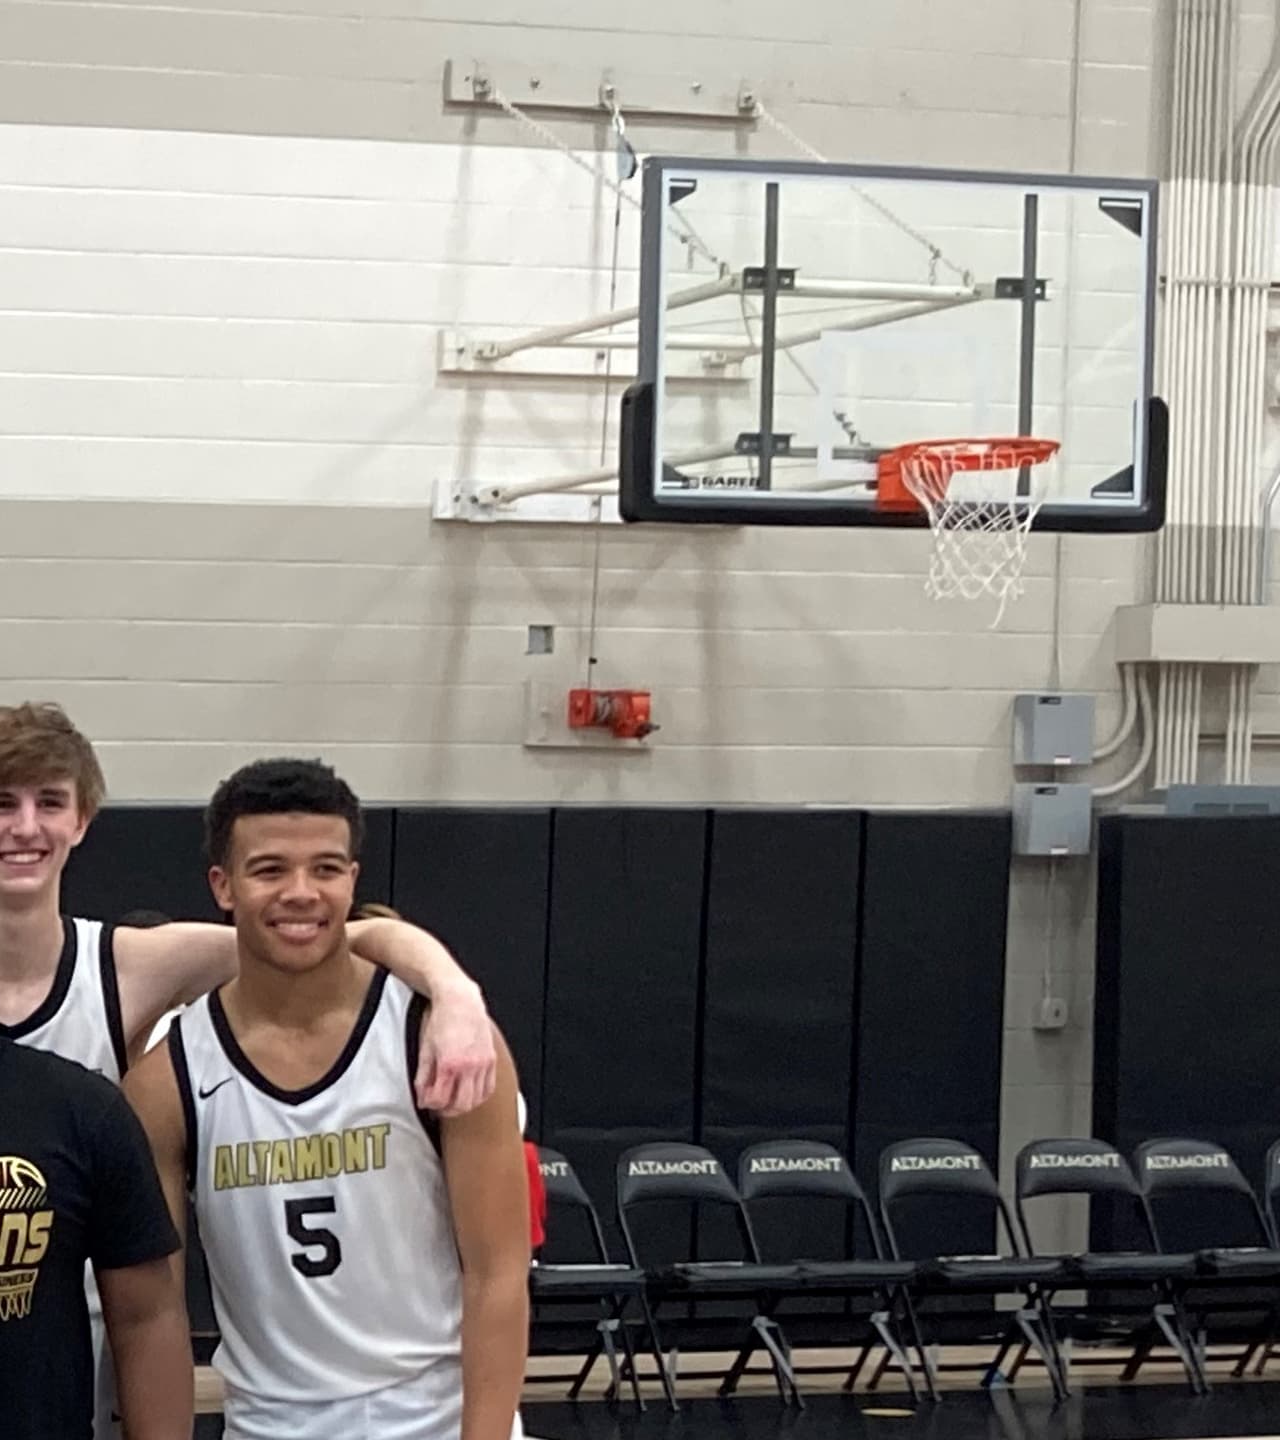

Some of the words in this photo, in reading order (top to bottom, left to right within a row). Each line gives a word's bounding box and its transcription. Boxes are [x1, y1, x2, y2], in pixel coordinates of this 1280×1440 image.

[214, 1123, 391, 1191] ALTAMONT
[750, 1157, 841, 1173] ALTAMONT
[891, 1155, 982, 1171] ALTAMONT
[1030, 1153, 1121, 1169] ALTAMONT
[1146, 1153, 1228, 1170] ALTAMONT
[629, 1160, 718, 1175] ALTAMONT
[284, 1196, 342, 1278] 5
